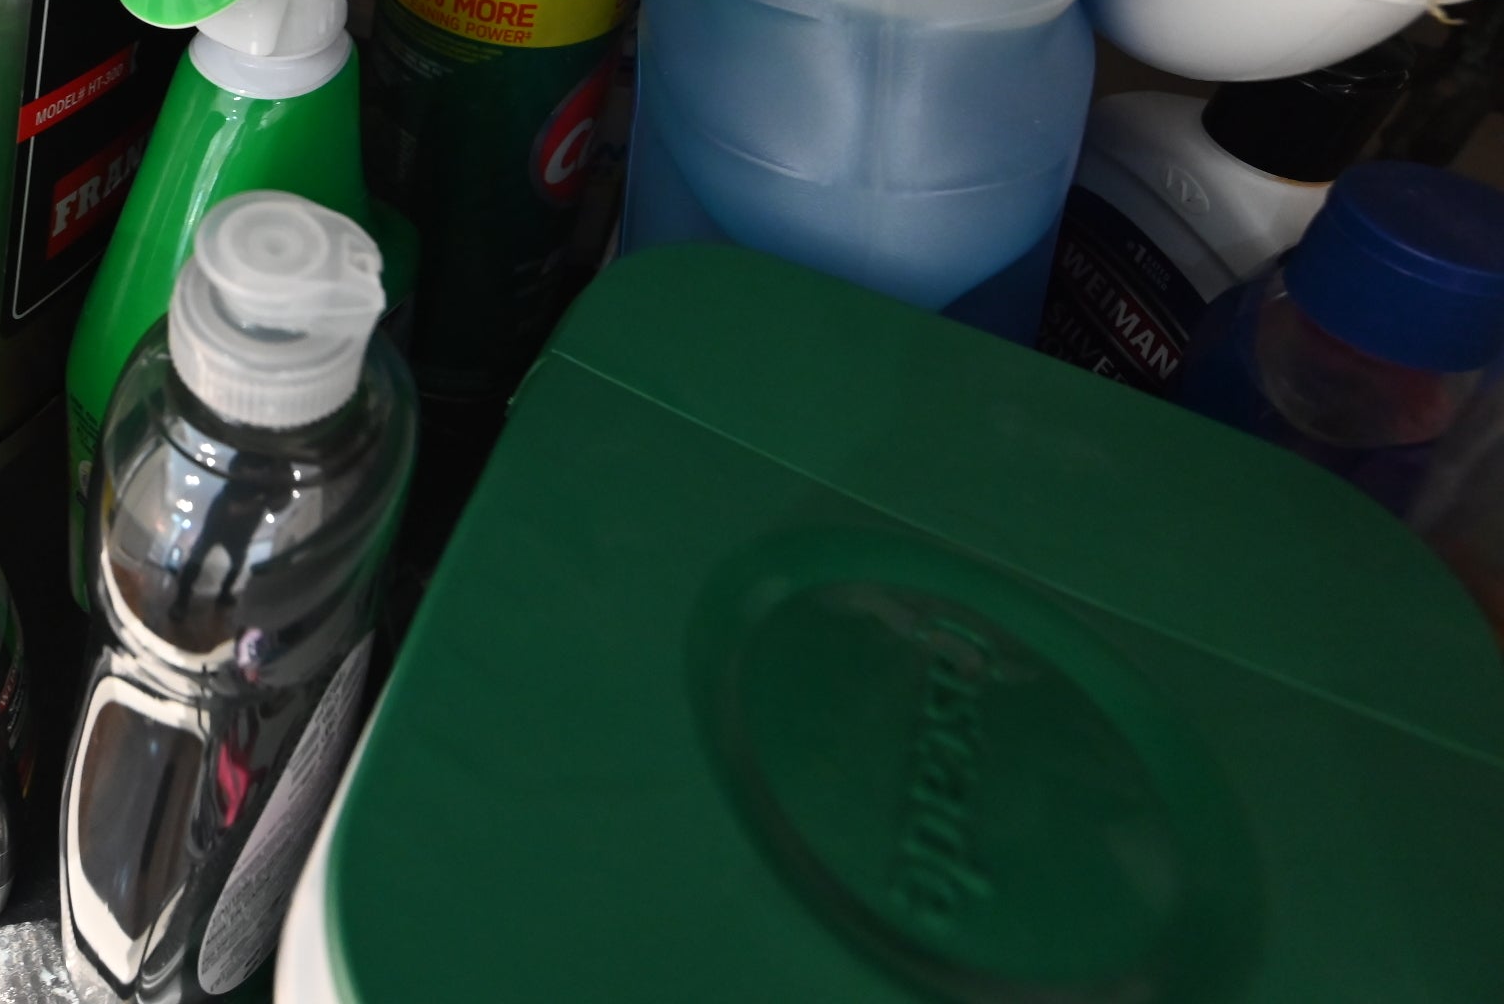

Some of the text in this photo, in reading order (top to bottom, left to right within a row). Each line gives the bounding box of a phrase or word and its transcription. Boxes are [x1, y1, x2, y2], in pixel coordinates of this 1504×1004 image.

[35, 62, 125, 126] MODEL# HT-300
[51, 132, 148, 238] FRAN
[1061, 241, 1181, 380] WEIMAN
